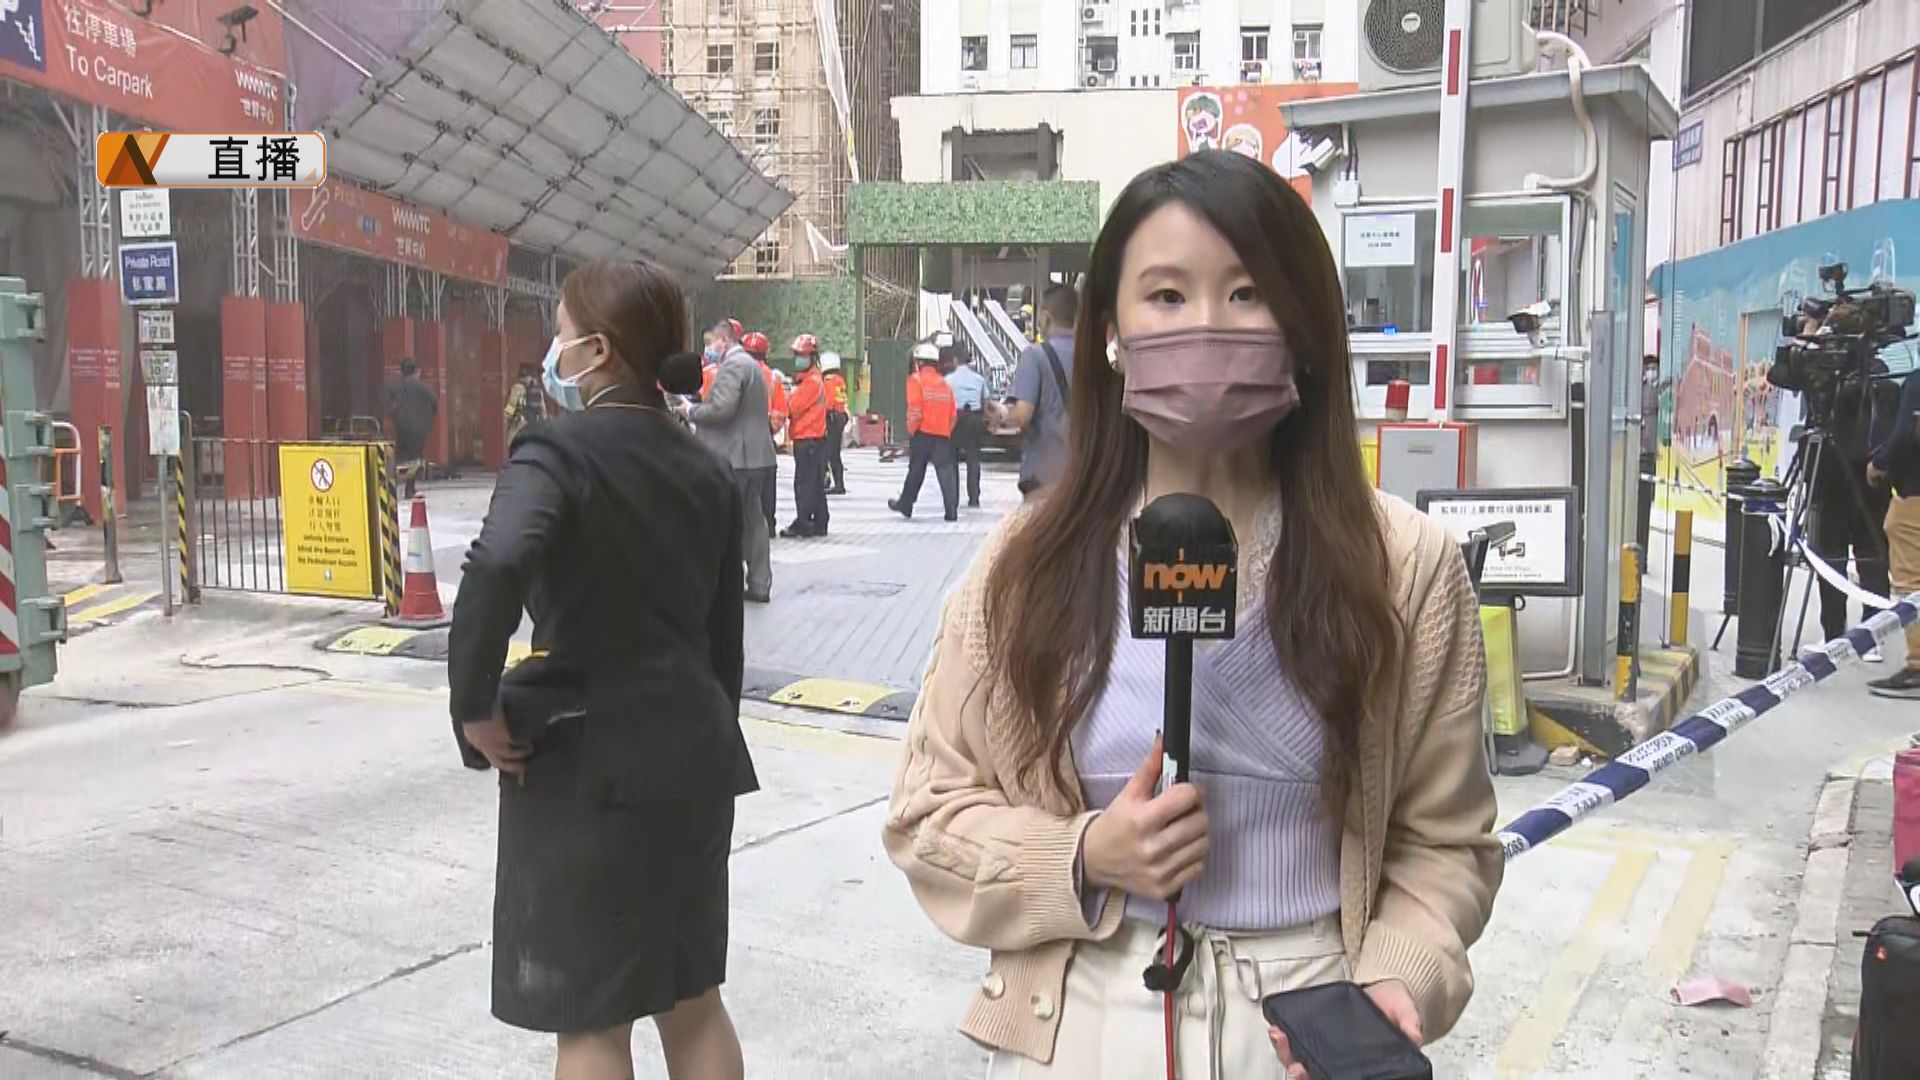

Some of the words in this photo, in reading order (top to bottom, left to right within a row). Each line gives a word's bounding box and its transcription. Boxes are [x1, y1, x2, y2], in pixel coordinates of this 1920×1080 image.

[64, 4, 137, 58] 往停車場
[65, 44, 89, 76] To
[94, 56, 153, 99] Carpark
[125, 255, 149, 268] Private
[150, 254, 171, 267] Road
[1144, 563, 1228, 590] now
[1143, 606, 1227, 634] 新聞台
